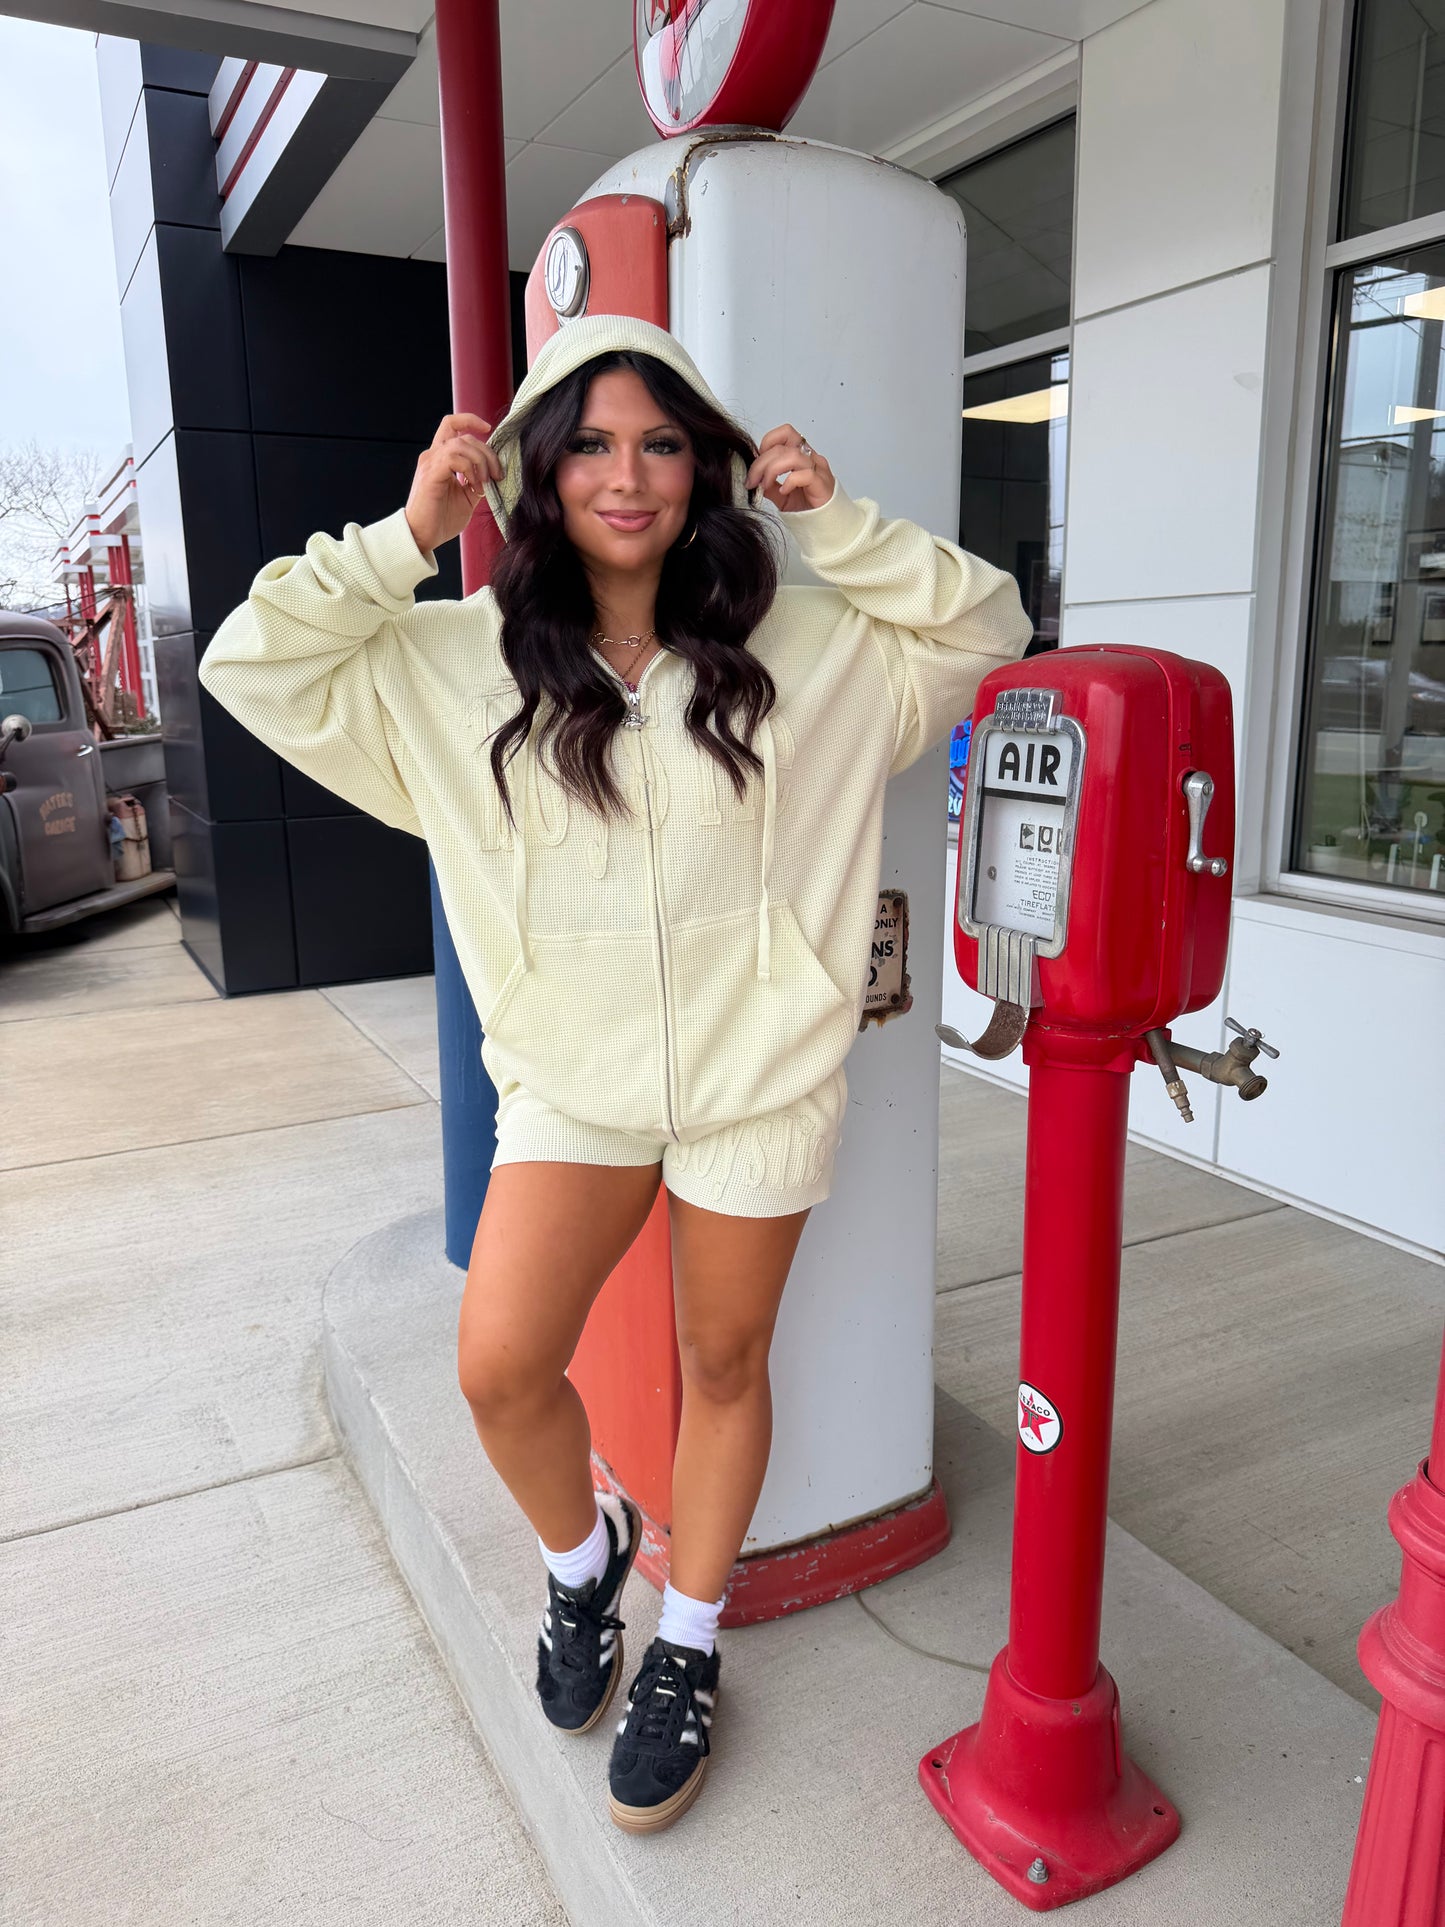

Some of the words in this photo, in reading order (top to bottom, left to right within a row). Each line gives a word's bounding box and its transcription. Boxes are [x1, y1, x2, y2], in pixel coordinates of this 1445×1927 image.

[998, 742, 1061, 785] AIR
[1032, 889, 1052, 901] ECO
[880, 904, 888, 914] A
[865, 993, 887, 1004] OUNDS
[1020, 1392, 1051, 1417] TEXACO
